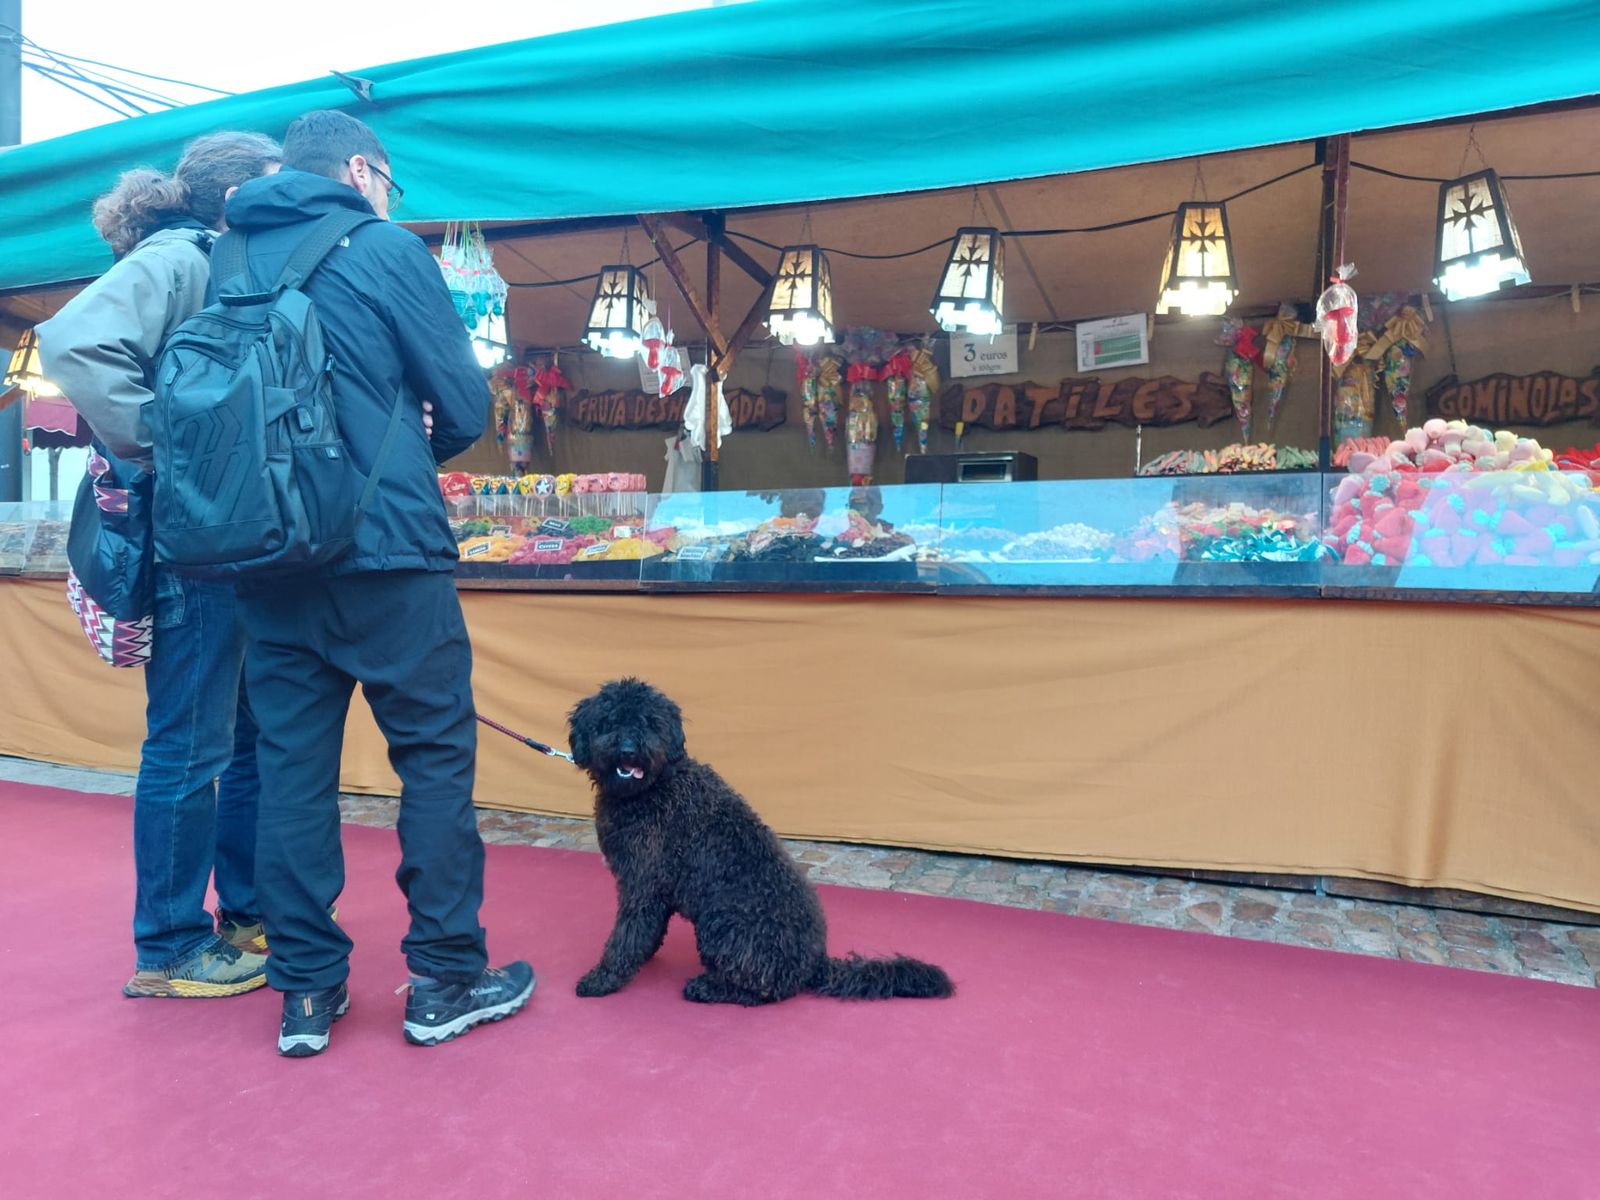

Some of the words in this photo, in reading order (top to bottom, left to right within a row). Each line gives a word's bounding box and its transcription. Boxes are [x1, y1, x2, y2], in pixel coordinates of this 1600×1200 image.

[964, 343, 976, 362] 3
[980, 351, 1008, 361] euros
[577, 392, 626, 426] FRUTA
